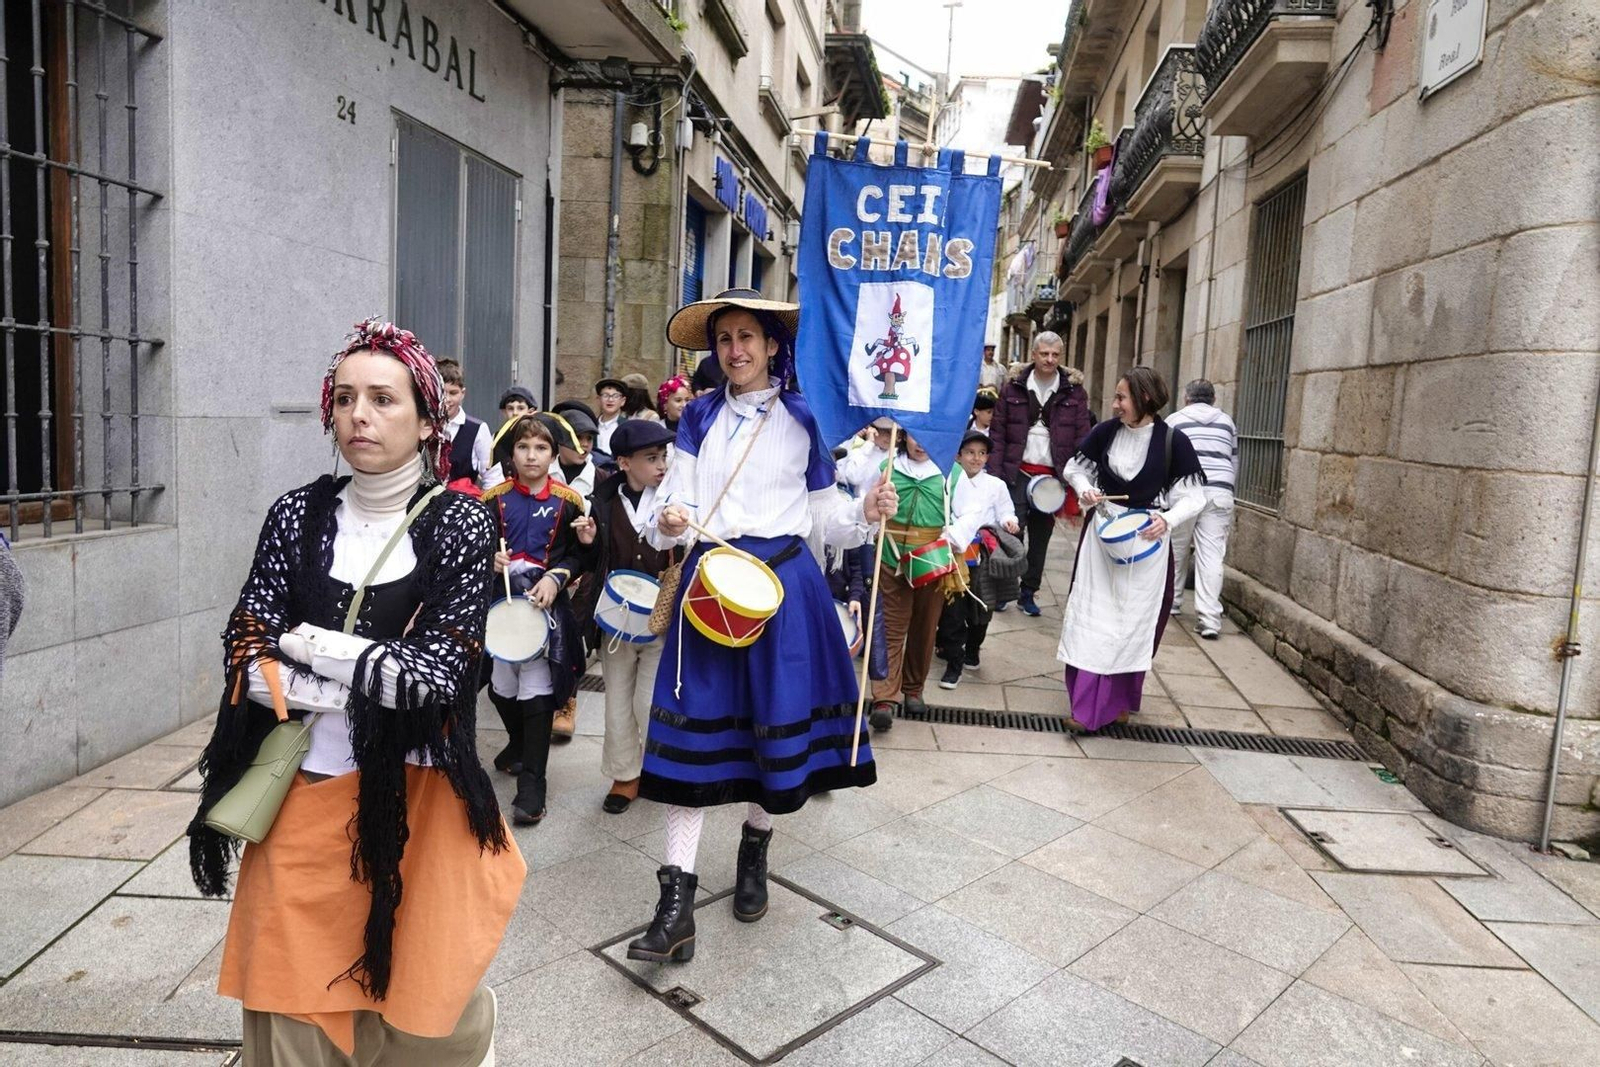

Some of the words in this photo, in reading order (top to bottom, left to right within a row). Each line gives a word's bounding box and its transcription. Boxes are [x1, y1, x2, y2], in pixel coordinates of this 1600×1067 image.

[1438, 42, 1461, 71] Real
[337, 95, 356, 125] 24
[856, 184, 950, 228] CEI
[532, 506, 554, 518] N
